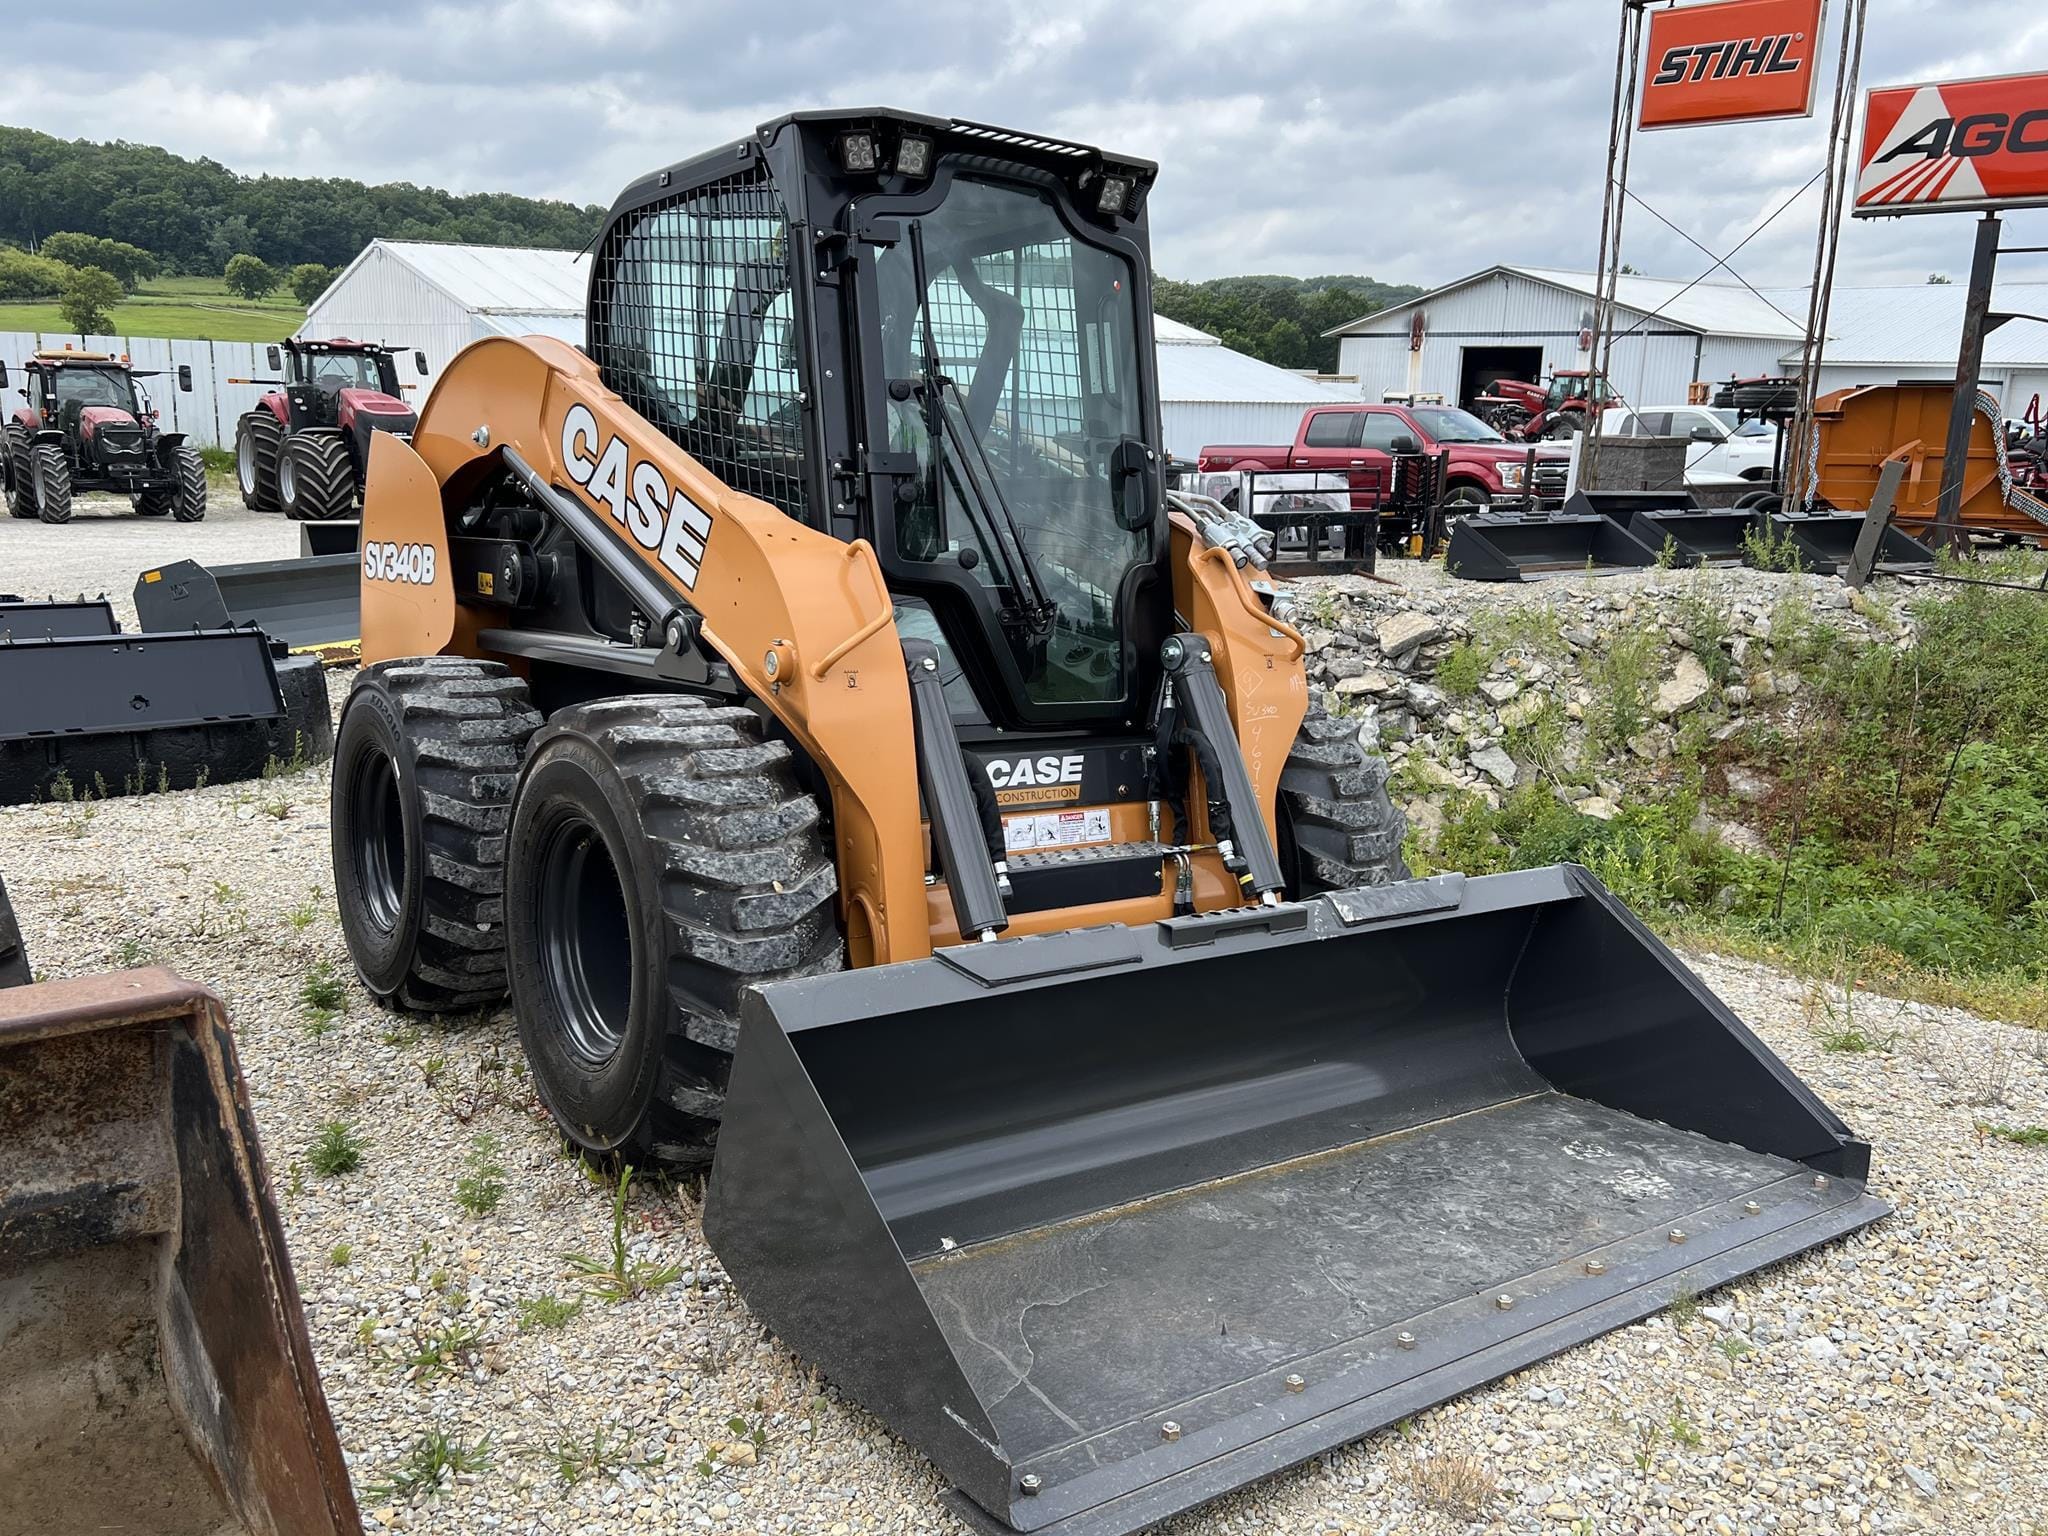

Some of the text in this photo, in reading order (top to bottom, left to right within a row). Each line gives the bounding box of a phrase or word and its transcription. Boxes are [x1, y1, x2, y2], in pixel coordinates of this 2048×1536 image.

[1652, 33, 1802, 86] STIHL
[562, 404, 712, 591] CASE
[364, 540, 435, 585] SV340B
[986, 755, 1085, 788] CASE
[996, 787, 1078, 804] CONSTRUCTION
